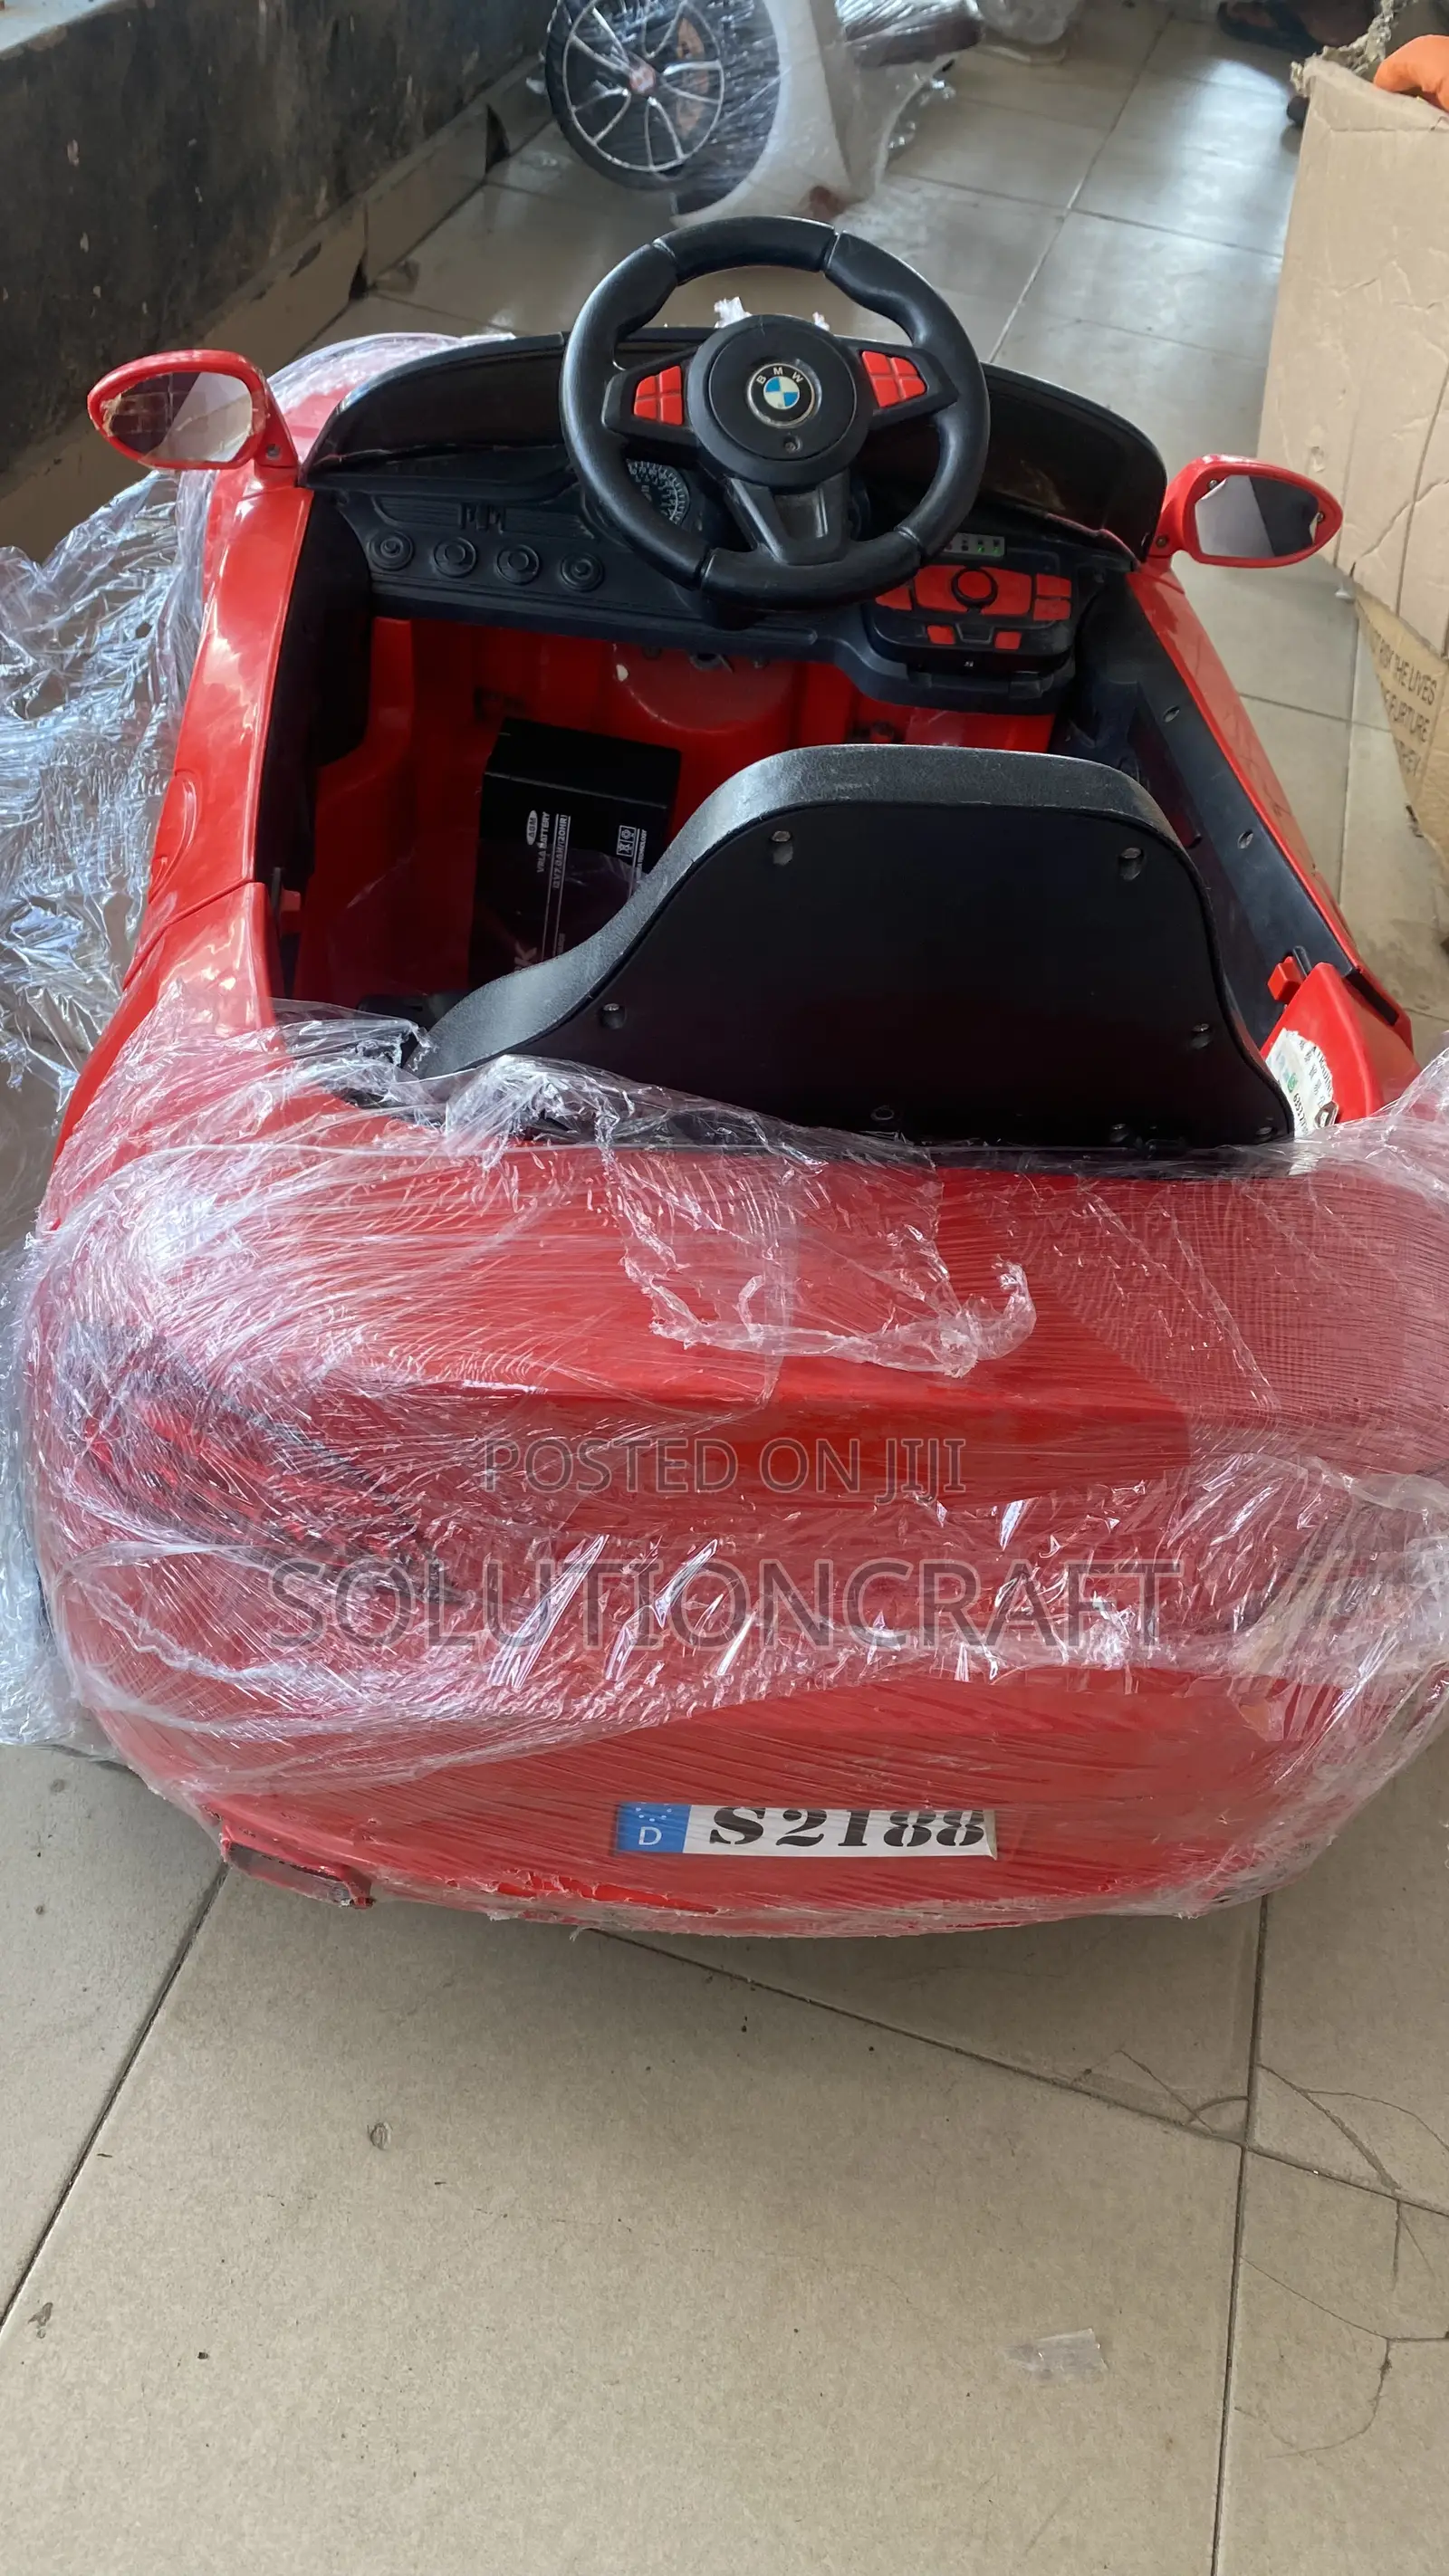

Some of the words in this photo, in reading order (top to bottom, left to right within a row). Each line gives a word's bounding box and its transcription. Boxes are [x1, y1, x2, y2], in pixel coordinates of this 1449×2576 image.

[756, 367, 804, 385] BMW
[1407, 666, 1437, 706] LIVES
[540, 811, 551, 849] BATTERY
[638, 1825, 663, 1846] D
[709, 1807, 985, 1848] S2188
